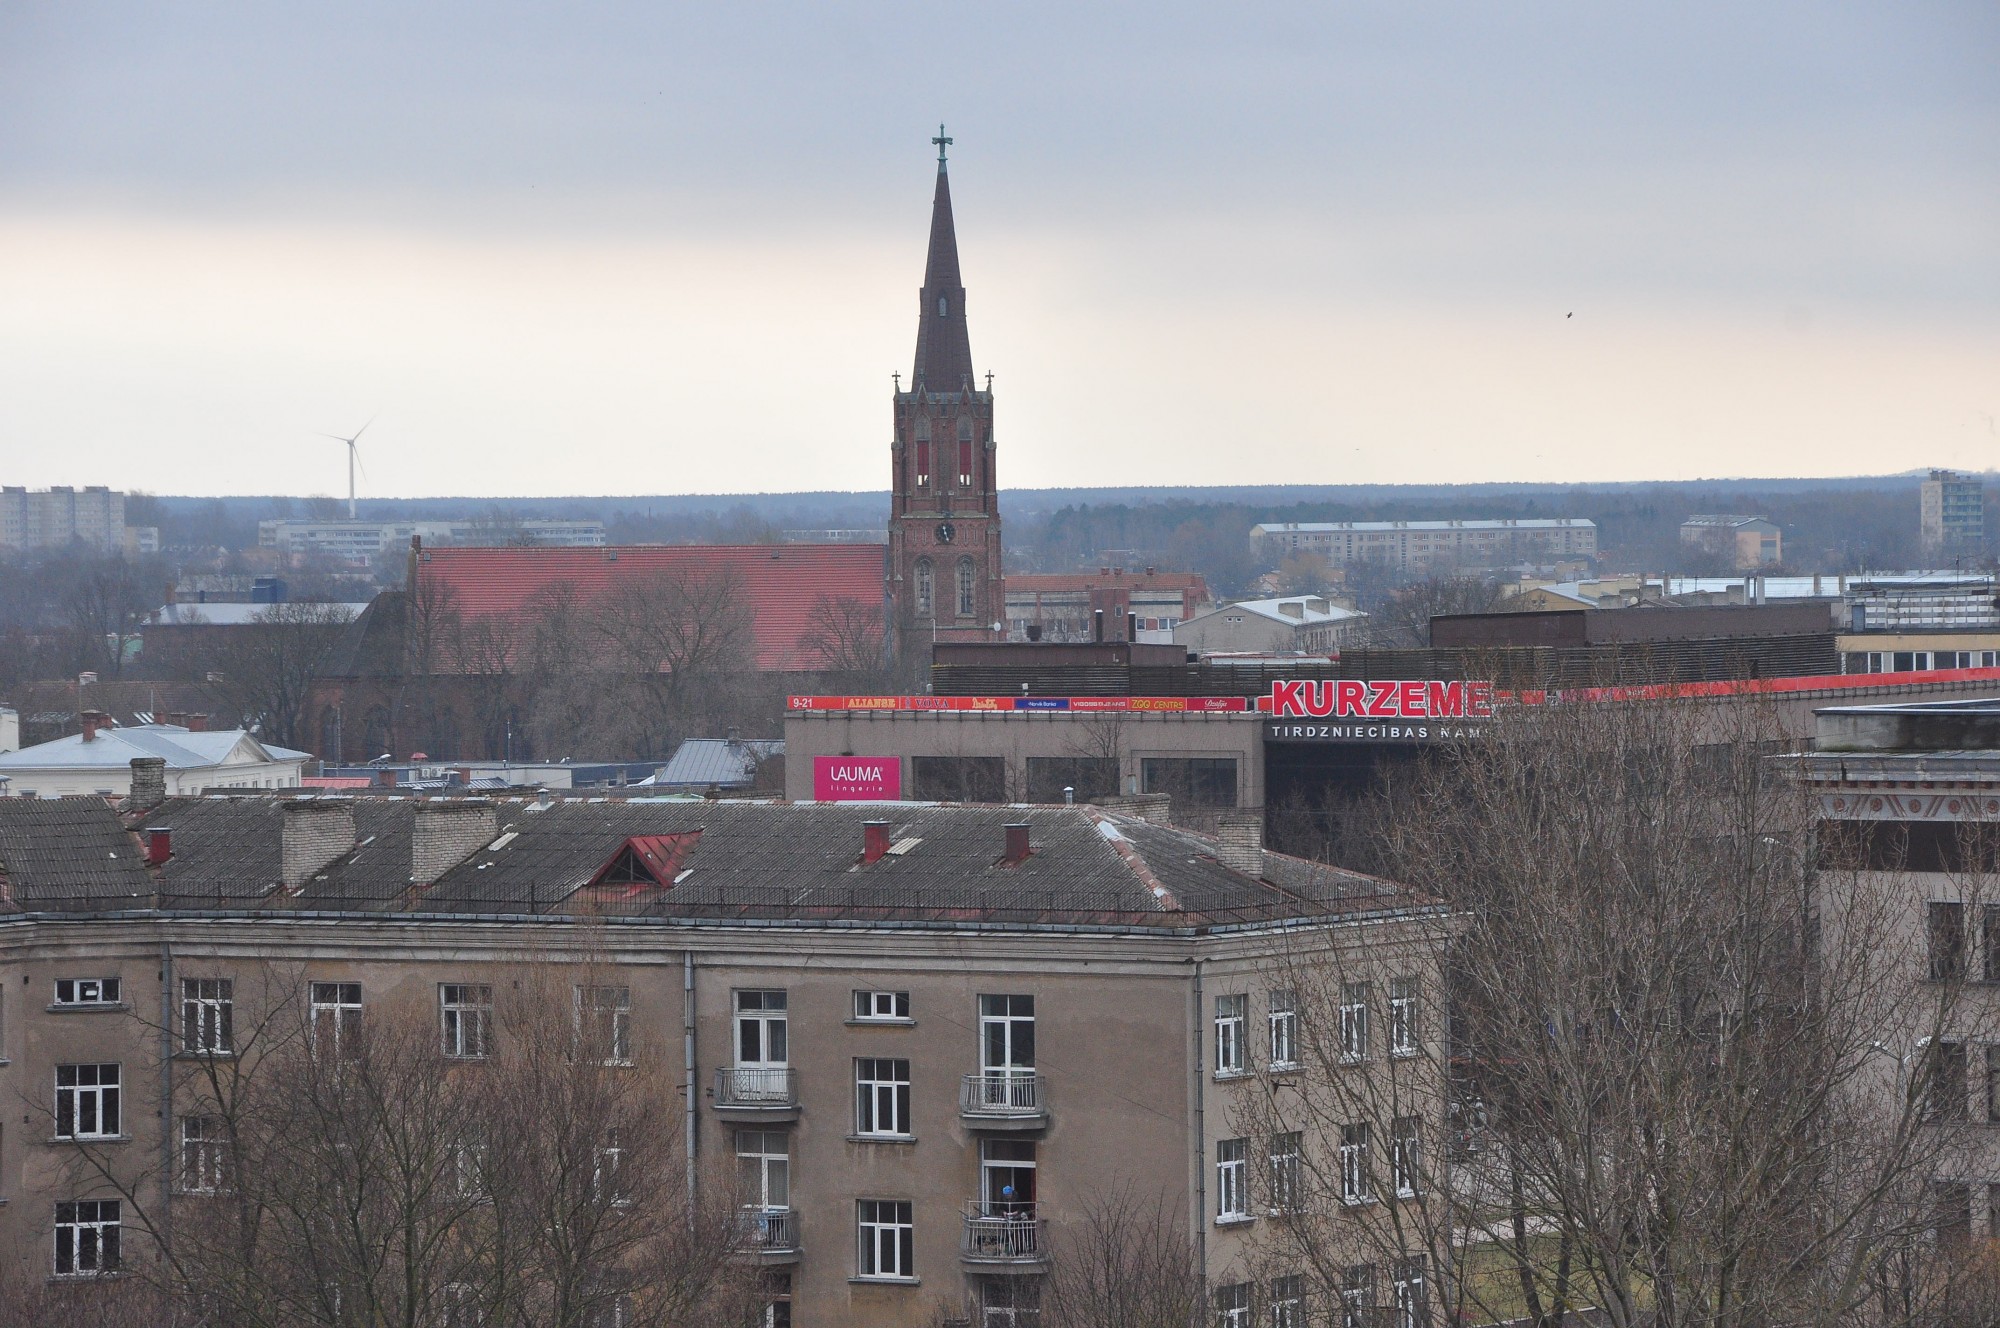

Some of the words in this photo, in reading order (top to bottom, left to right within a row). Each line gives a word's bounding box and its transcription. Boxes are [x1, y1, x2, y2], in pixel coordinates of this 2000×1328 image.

[793, 698, 813, 708] 9-21
[1131, 699, 1151, 709] ZOO
[1153, 700, 1184, 709] CENTRS
[1272, 680, 1492, 718] KURZEME
[1272, 725, 1428, 738] TIRDZNIECĪBAS
[1440, 727, 1489, 738] NAM
[830, 766, 882, 782] LAUMA
[830, 785, 883, 793] lingerie
